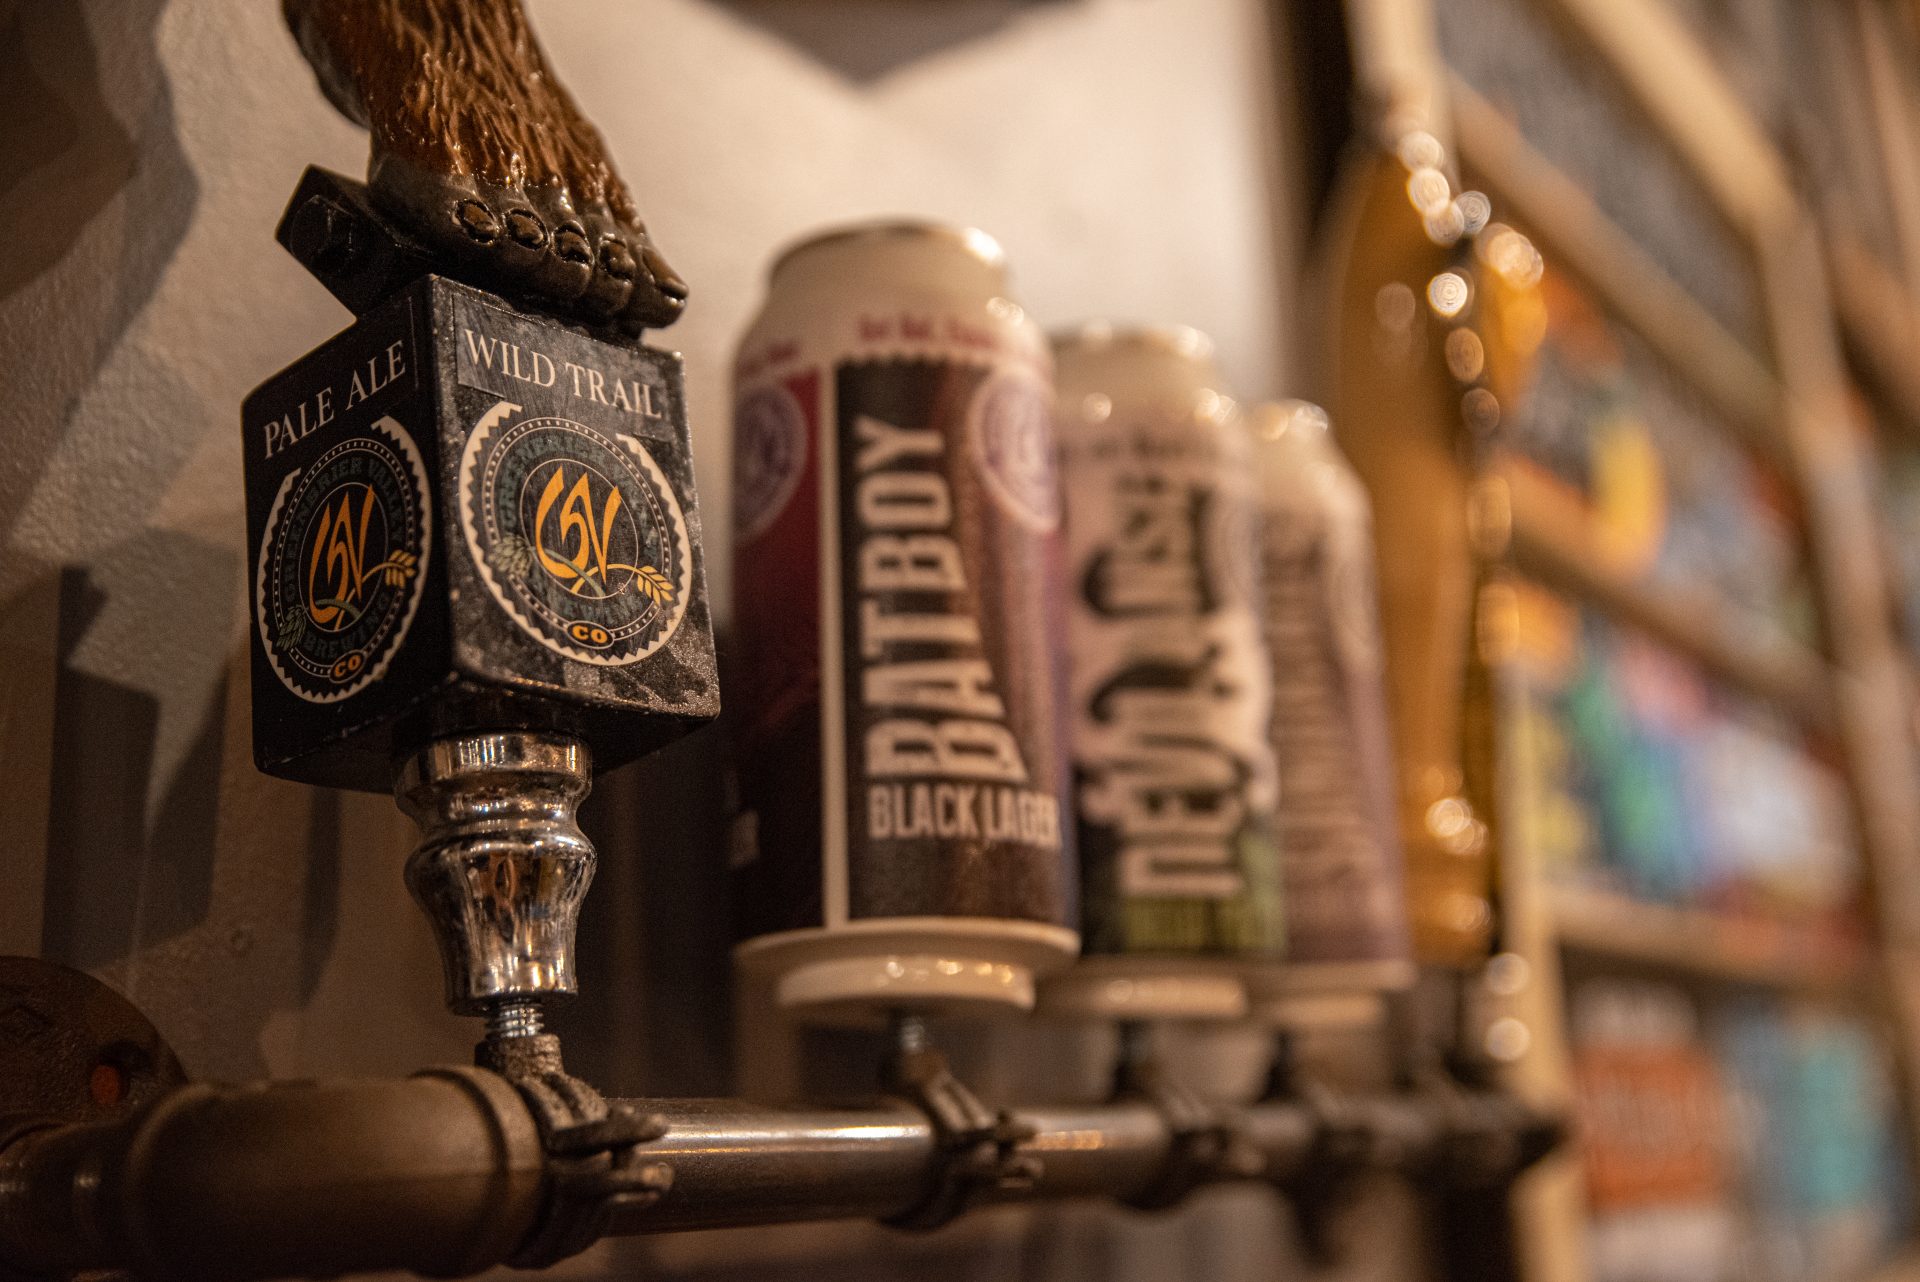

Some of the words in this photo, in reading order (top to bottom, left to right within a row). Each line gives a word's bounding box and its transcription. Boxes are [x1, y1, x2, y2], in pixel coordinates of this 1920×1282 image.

[264, 387, 335, 460] PALE
[345, 340, 406, 411] ALE
[465, 329, 555, 388] WILD
[565, 362, 662, 419] TRAIL
[571, 624, 609, 644] CO
[856, 416, 1028, 780] BATBOY
[334, 654, 362, 678] CO
[868, 784, 980, 840] BLACK
